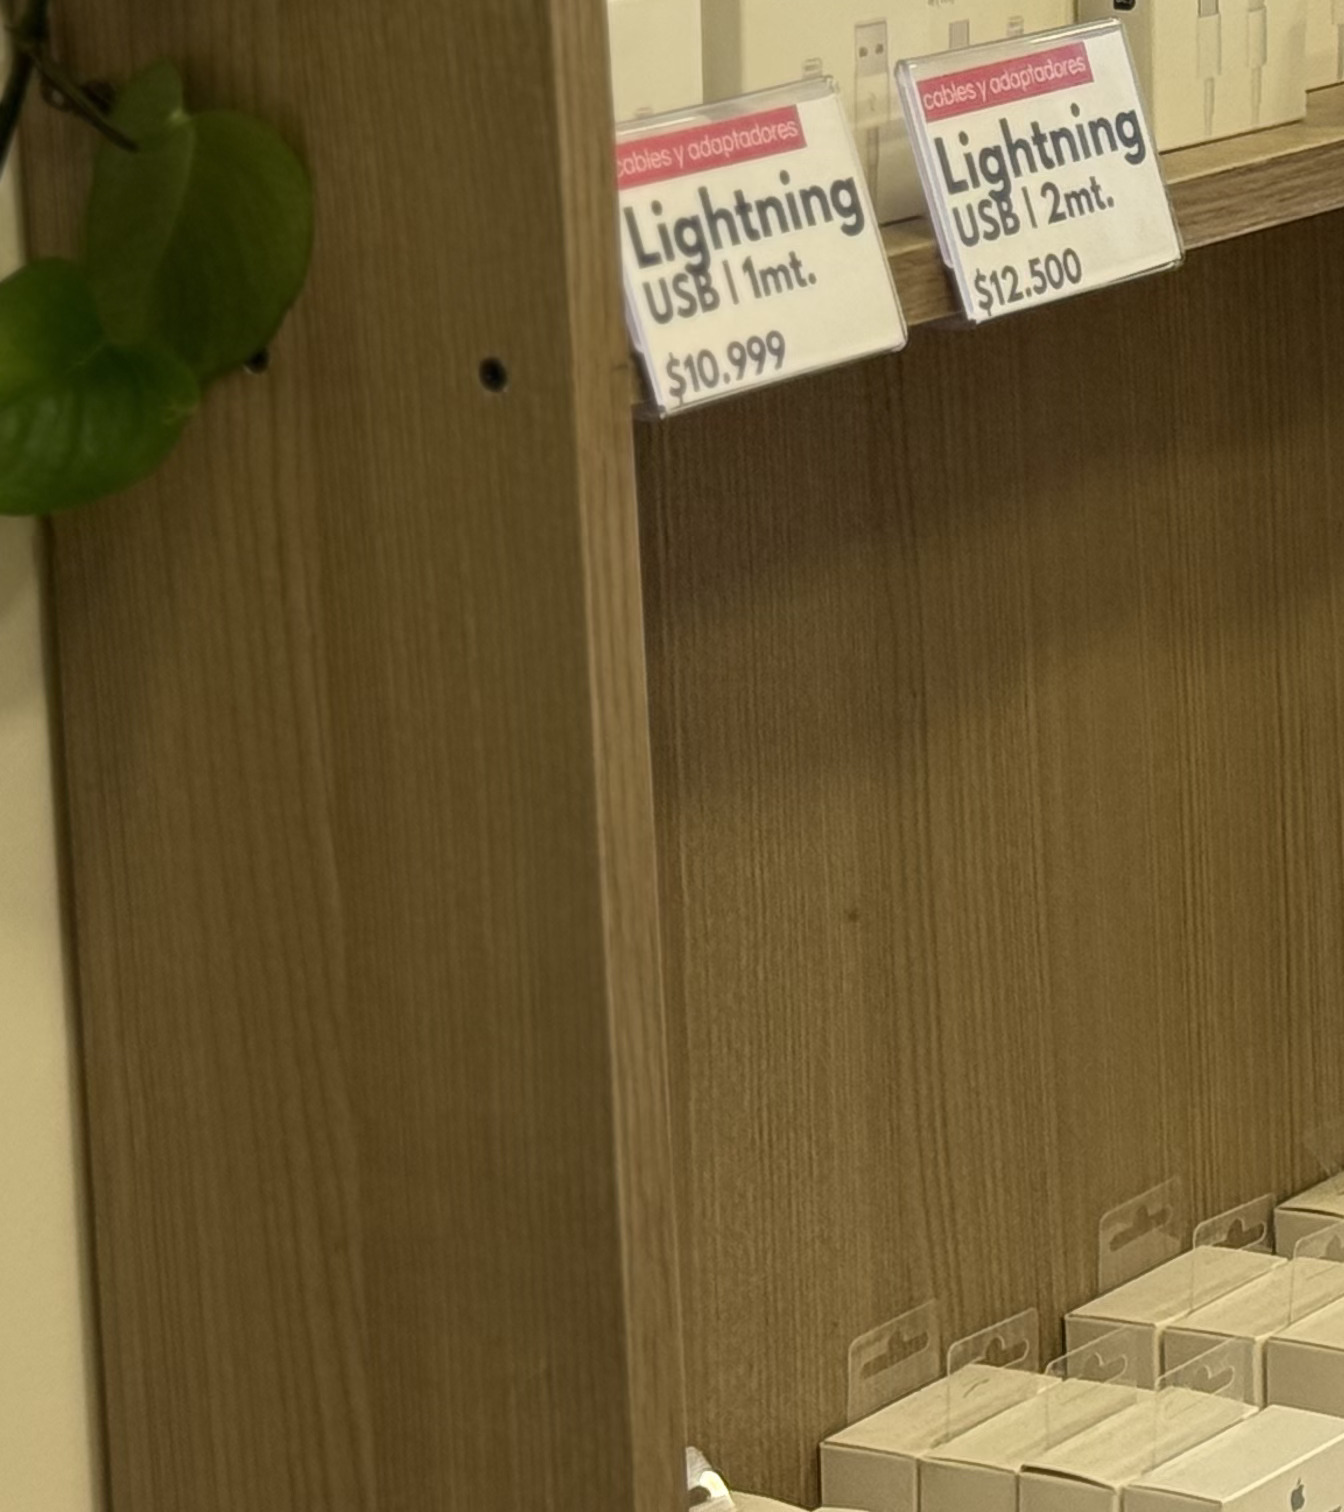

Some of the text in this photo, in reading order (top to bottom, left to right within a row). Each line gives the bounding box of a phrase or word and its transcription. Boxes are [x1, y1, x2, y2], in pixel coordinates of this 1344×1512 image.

[922, 55, 1087, 111] cables y adaptadores
[674, 144, 688, 169] y
[686, 118, 800, 161] adaptadores
[934, 102, 1147, 200] Lightning
[623, 169, 866, 274] Lightning
[952, 194, 1021, 248] USB
[1040, 175, 1115, 225] 2mt.
[642, 268, 721, 325] USB
[742, 251, 818, 299] 1mt.
[973, 248, 1083, 317] $12.500
[666, 330, 786, 407] $10.999
